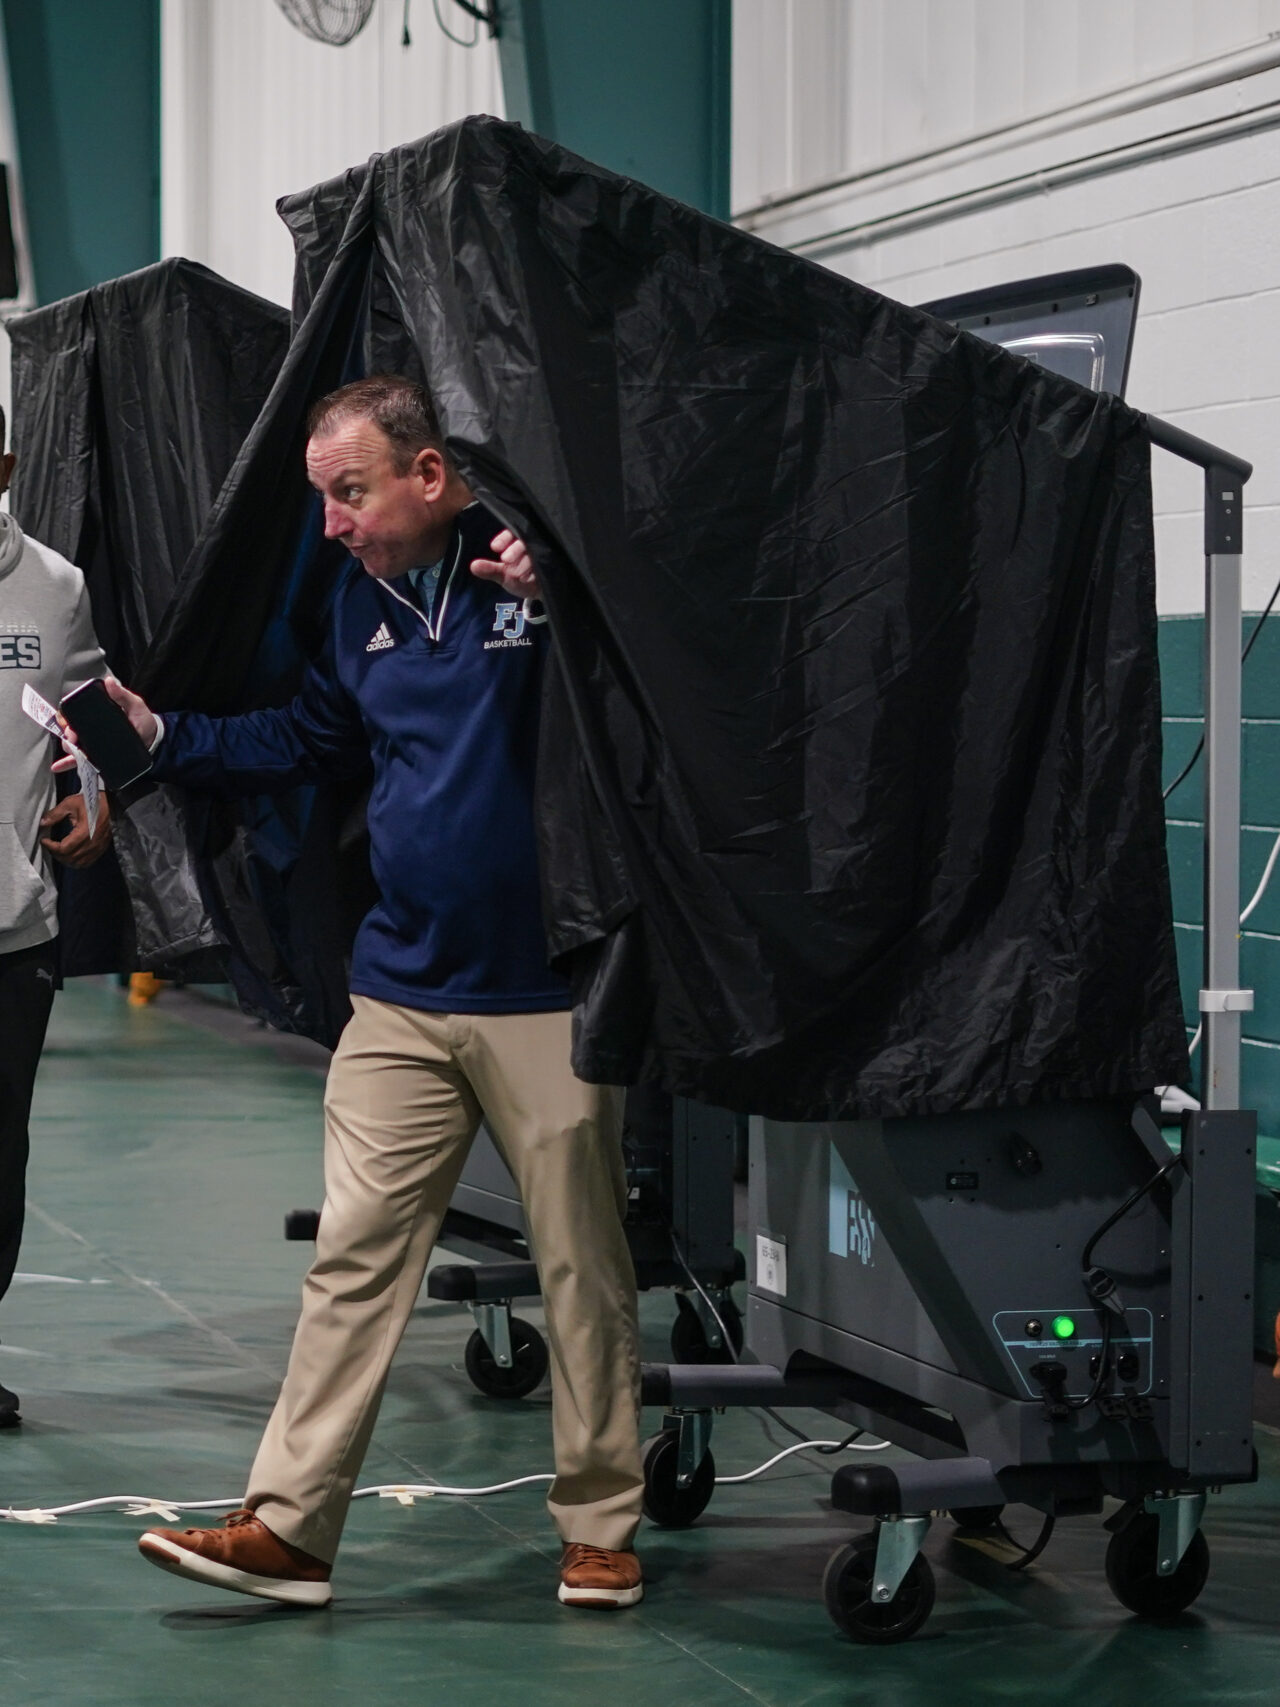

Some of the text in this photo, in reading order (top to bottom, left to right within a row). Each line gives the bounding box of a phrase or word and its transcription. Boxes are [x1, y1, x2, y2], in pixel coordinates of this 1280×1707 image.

[492, 602, 525, 639] FJ
[366, 637, 395, 652] adidas
[483, 637, 532, 650] BASKETBALL
